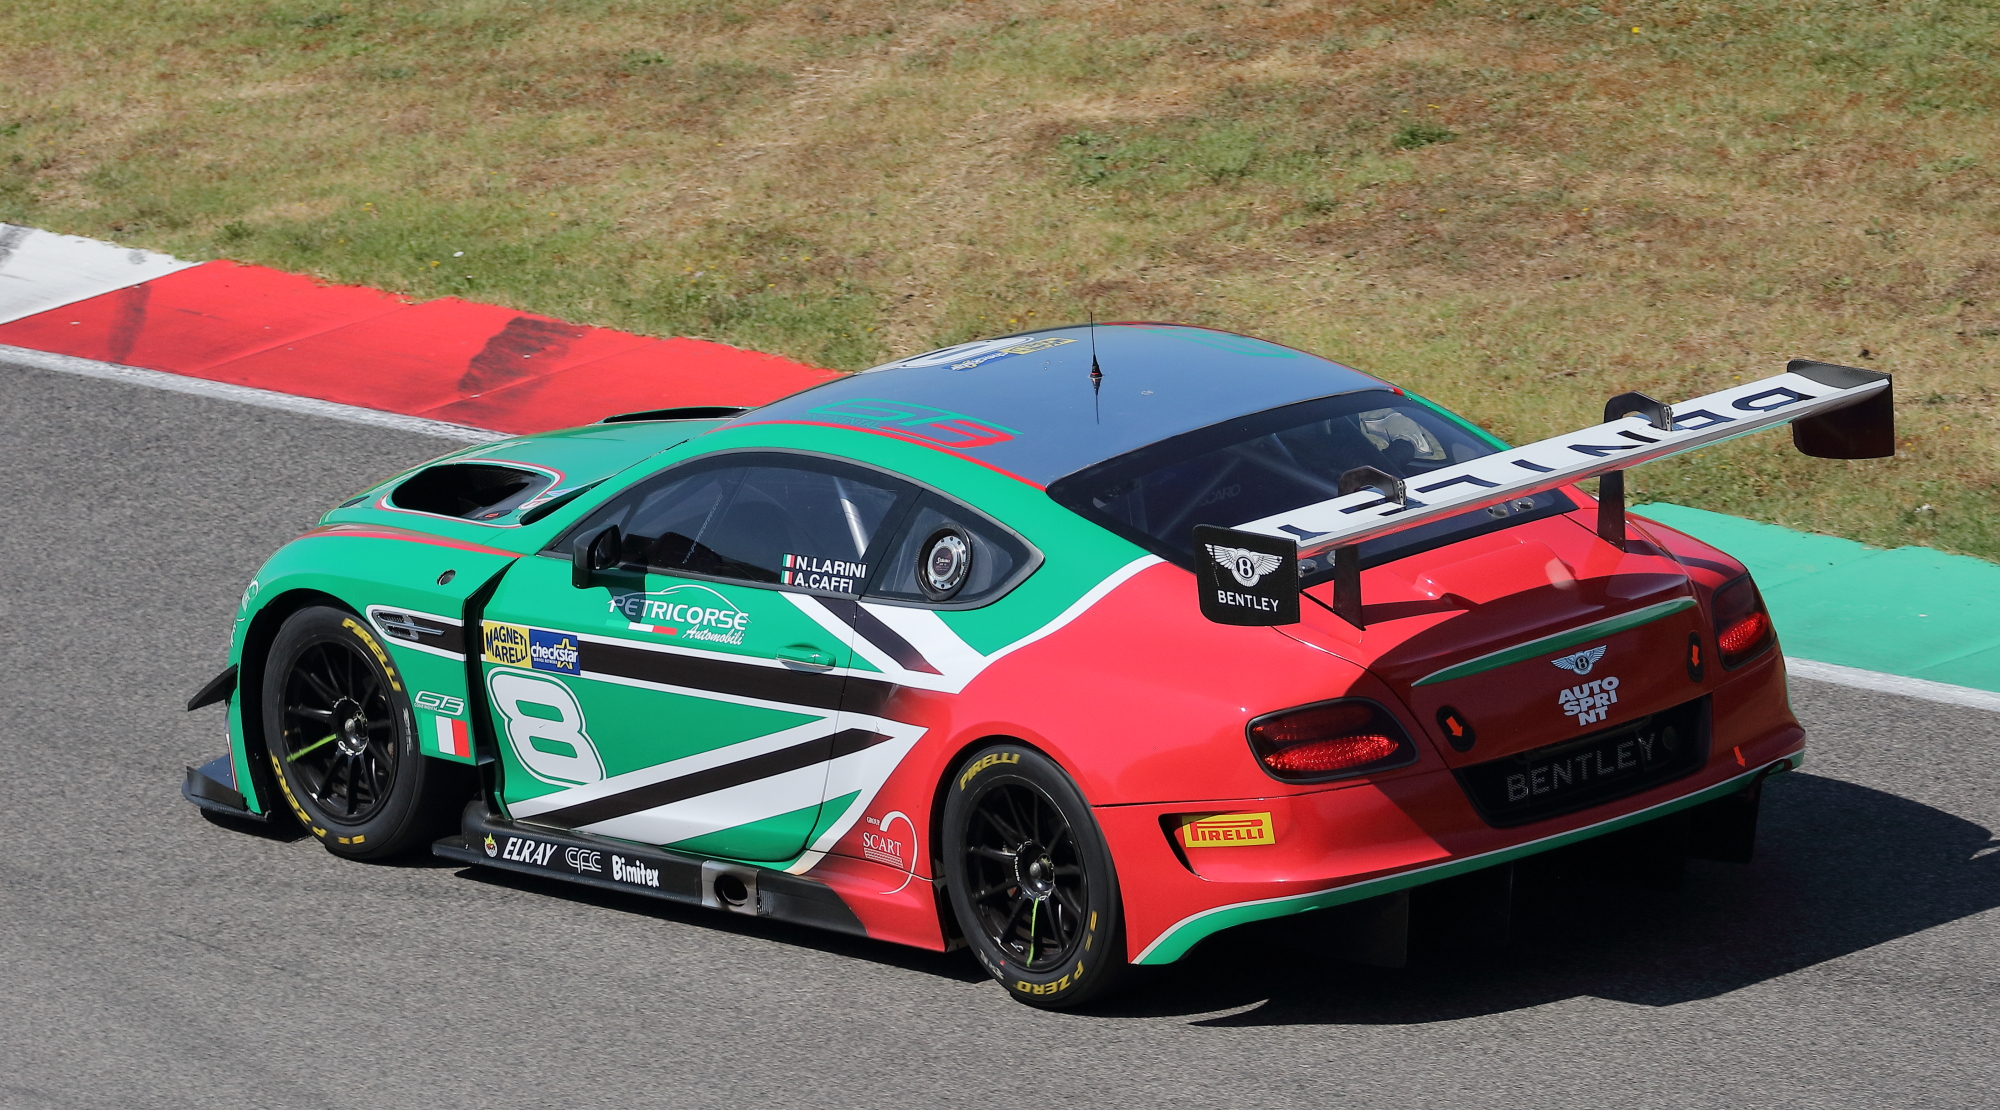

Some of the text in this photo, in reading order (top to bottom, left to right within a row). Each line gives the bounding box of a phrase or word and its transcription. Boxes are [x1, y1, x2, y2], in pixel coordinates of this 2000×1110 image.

[789, 411, 881, 430] CONTINENTAL
[806, 397, 1024, 449] GT3
[796, 555, 867, 579] N.LARINI
[794, 572, 854, 594] A.CAFFI
[1217, 589, 1279, 612] BENTLEY
[607, 596, 749, 631] PETRICORSE
[486, 626, 527, 652] MAGNETI
[682, 623, 745, 646] Automobili
[342, 617, 402, 692] PIRELLI
[486, 640, 528, 664] MARELLI
[530, 641, 578, 664] checkstar
[414, 690, 465, 716] GT3
[1558, 676, 1619, 705] AUTO
[1563, 689, 1618, 716] SPRI
[486, 666, 607, 789] 8
[1578, 705, 1609, 727] NT
[959, 752, 1020, 791] PIRELLI
[1506, 732, 1656, 802] BENTLEY
[1189, 819, 1264, 841] PIRELLI
[863, 832, 902, 856] SCART
[503, 836, 558, 866] ELRAY
[612, 854, 660, 888] Bimitex
[1016, 976, 1073, 995] ZERO
